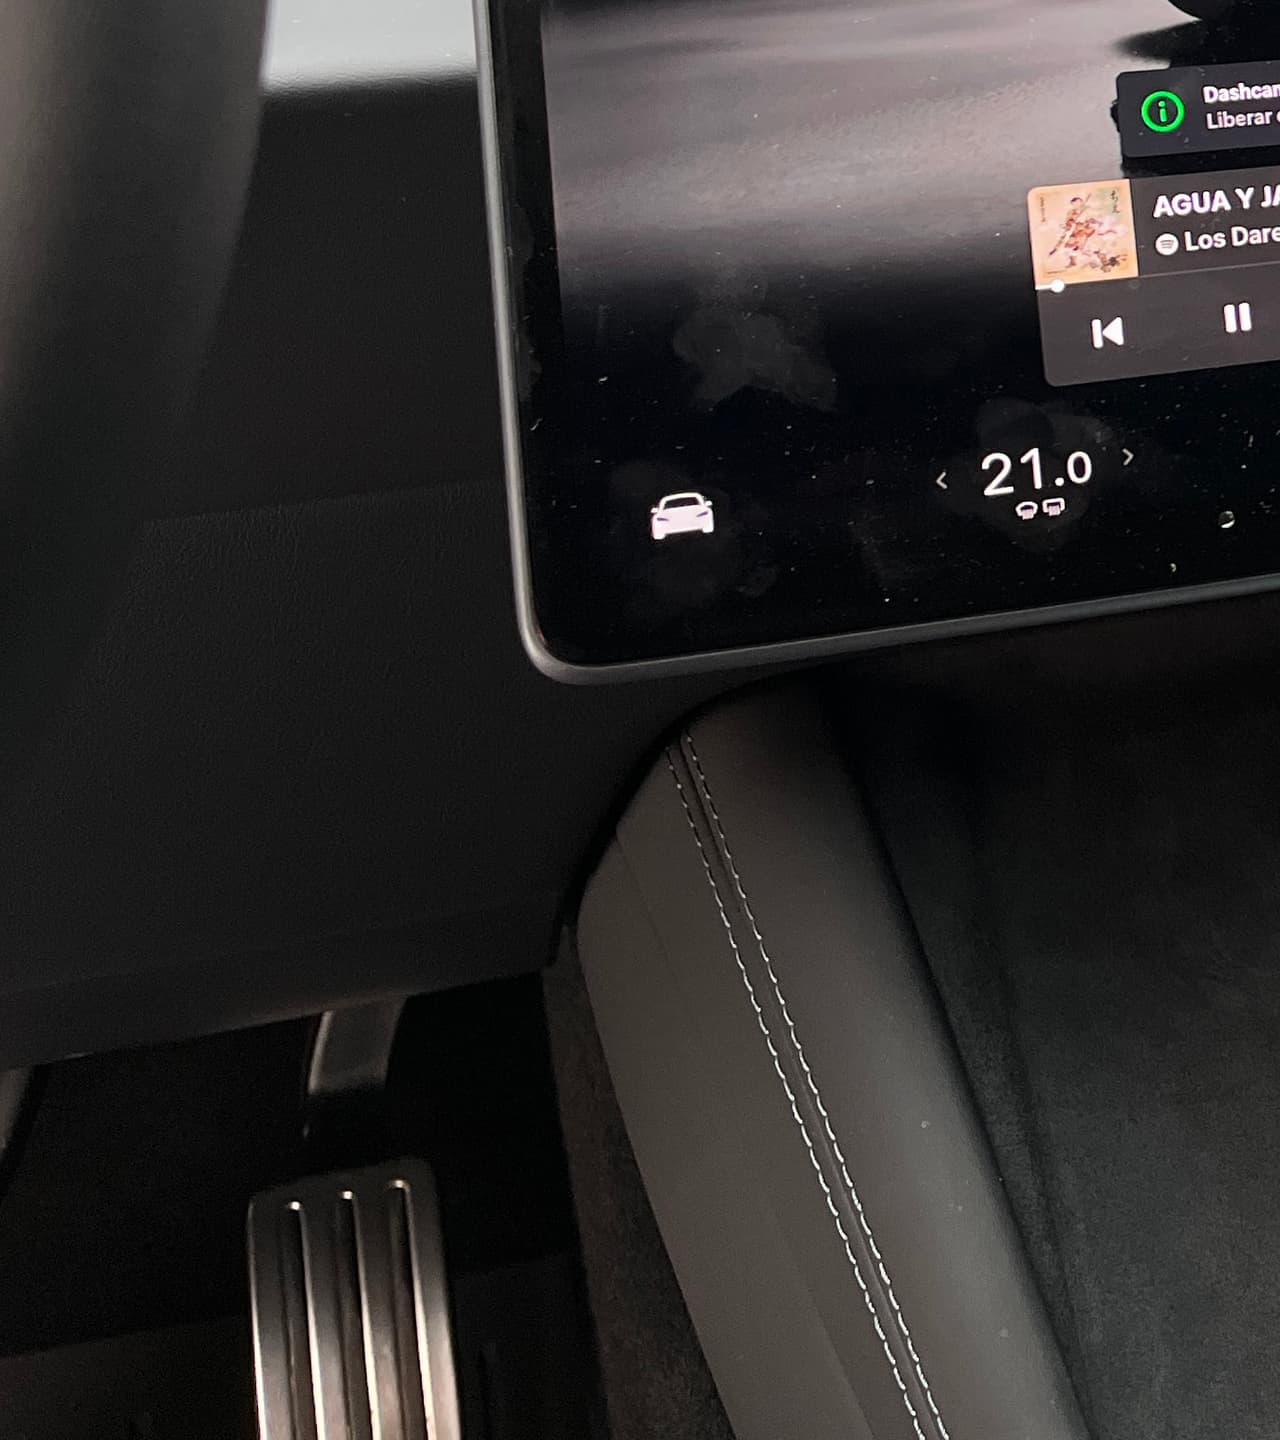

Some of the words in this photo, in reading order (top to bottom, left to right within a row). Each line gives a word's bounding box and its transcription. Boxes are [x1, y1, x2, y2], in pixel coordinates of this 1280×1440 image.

[1206, 111, 1273, 130] Liberar
[1152, 191, 1231, 218] AGUA
[1233, 187, 1255, 211] Y
[1183, 226, 1227, 252] Los
[981, 447, 1092, 496] 21.0
